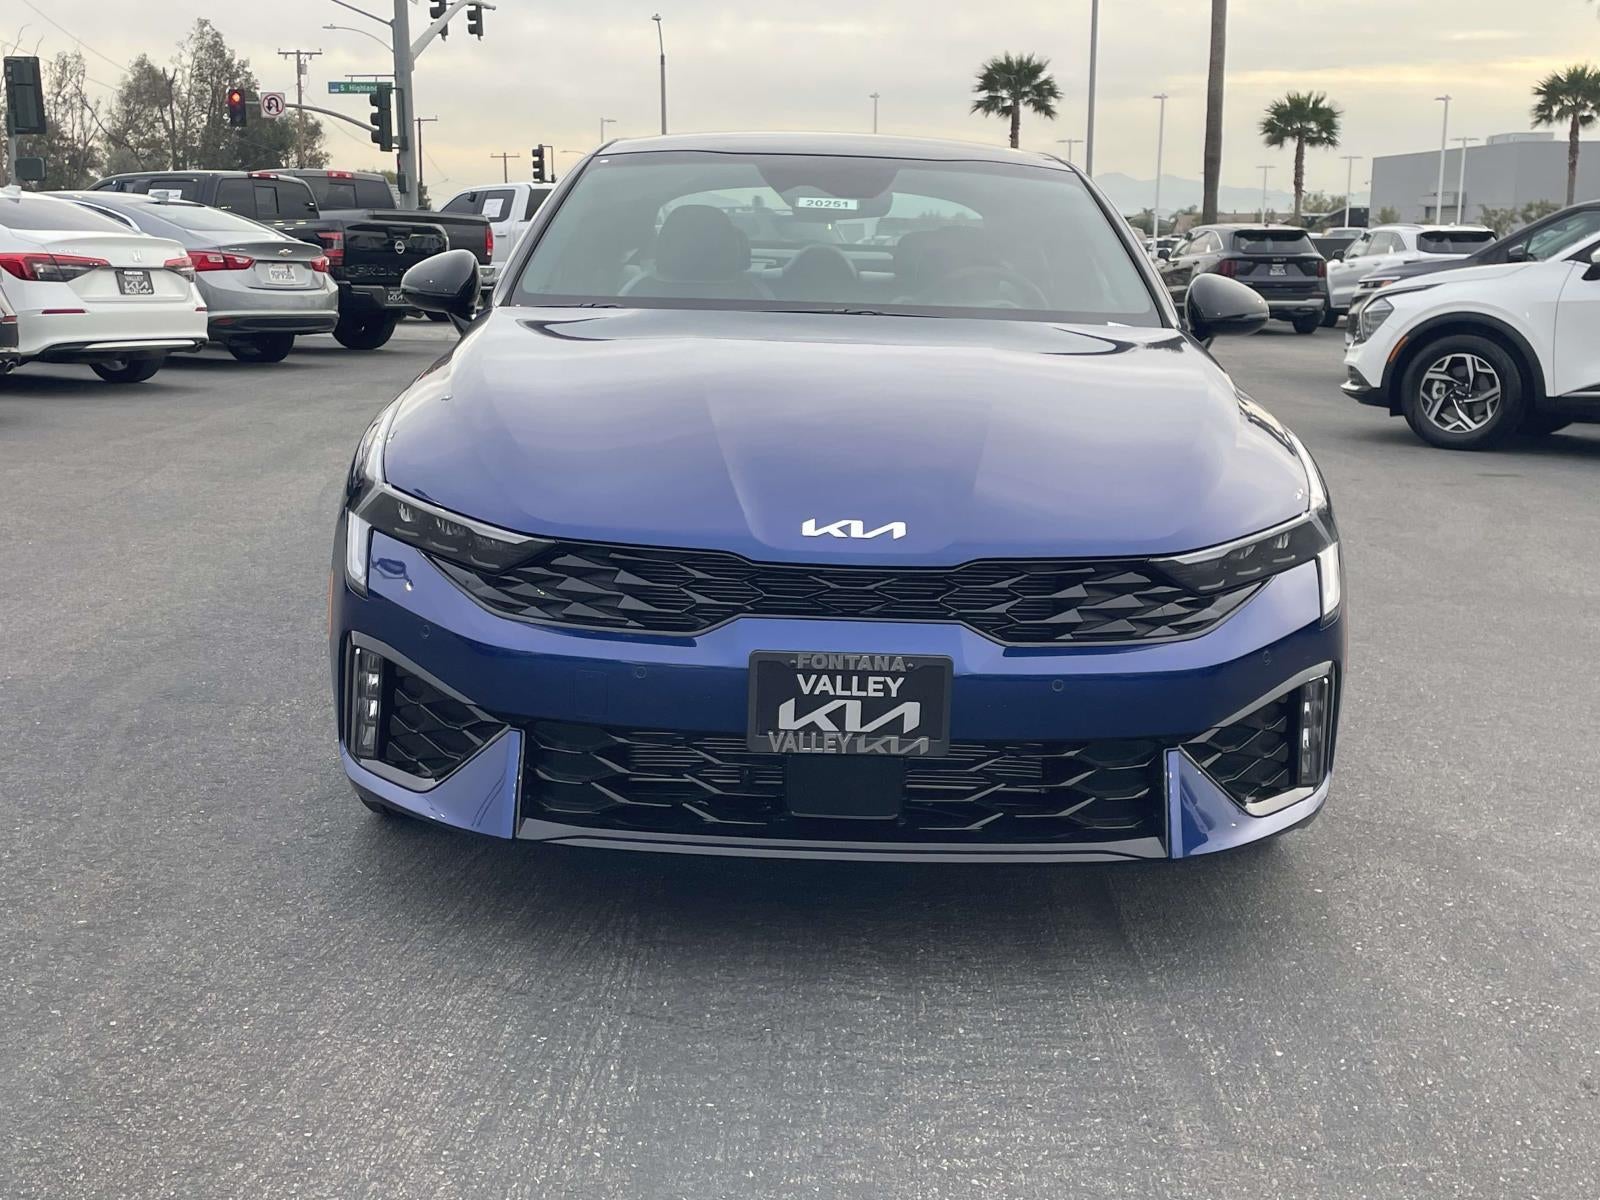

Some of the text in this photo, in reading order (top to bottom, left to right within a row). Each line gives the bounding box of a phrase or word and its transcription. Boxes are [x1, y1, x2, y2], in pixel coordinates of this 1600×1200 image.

[806, 199, 848, 208] 20251
[802, 518, 907, 540] KIA
[797, 653, 907, 672] FONTANA
[797, 674, 904, 697] VALLEY
[778, 697, 921, 734] KIA
[768, 731, 929, 755] VALLEY KIA
